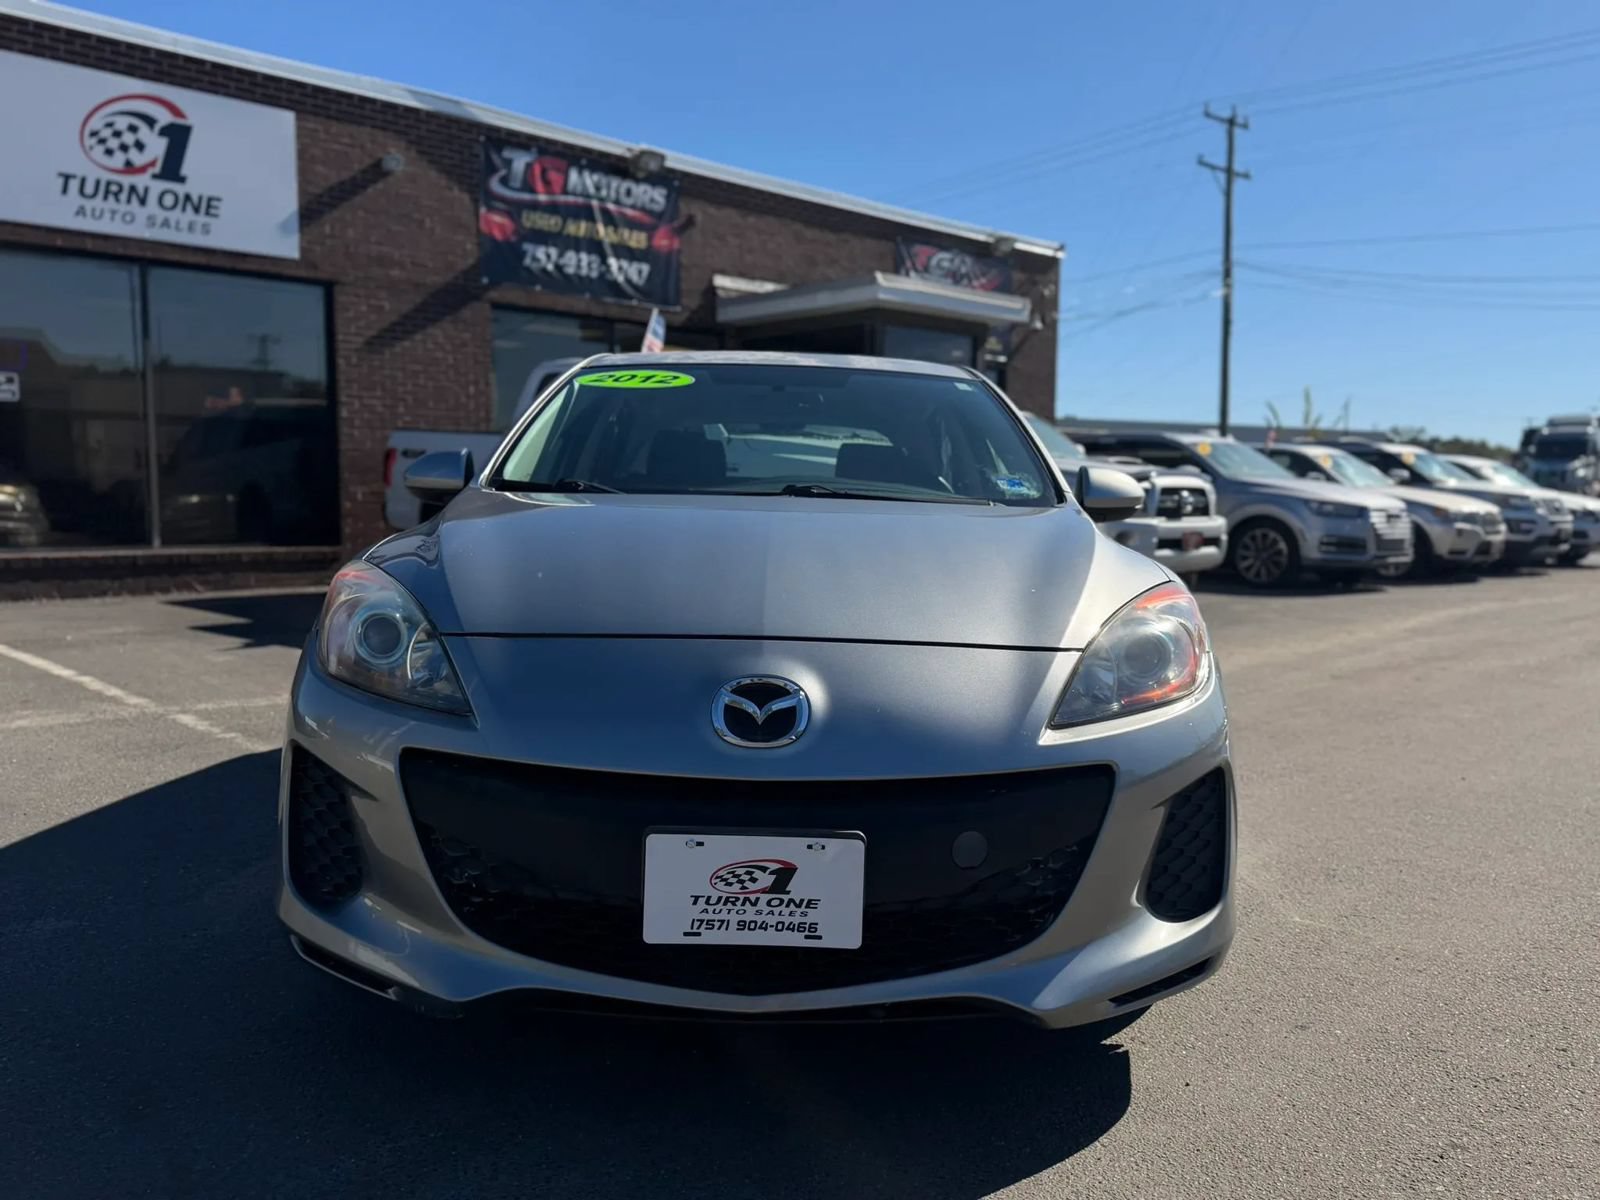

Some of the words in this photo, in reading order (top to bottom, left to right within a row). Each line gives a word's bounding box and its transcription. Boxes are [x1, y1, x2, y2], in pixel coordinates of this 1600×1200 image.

[57, 172, 149, 207] TURN
[157, 188, 223, 218] ONE
[74, 204, 136, 225] AUTO
[145, 213, 212, 236] SALES
[585, 374, 680, 385] 2012
[690, 895, 760, 908] TURN
[766, 897, 821, 910] ONE
[699, 908, 748, 916] AUTO
[754, 909, 809, 918] SALES
[736, 919, 819, 934] 904-0466
